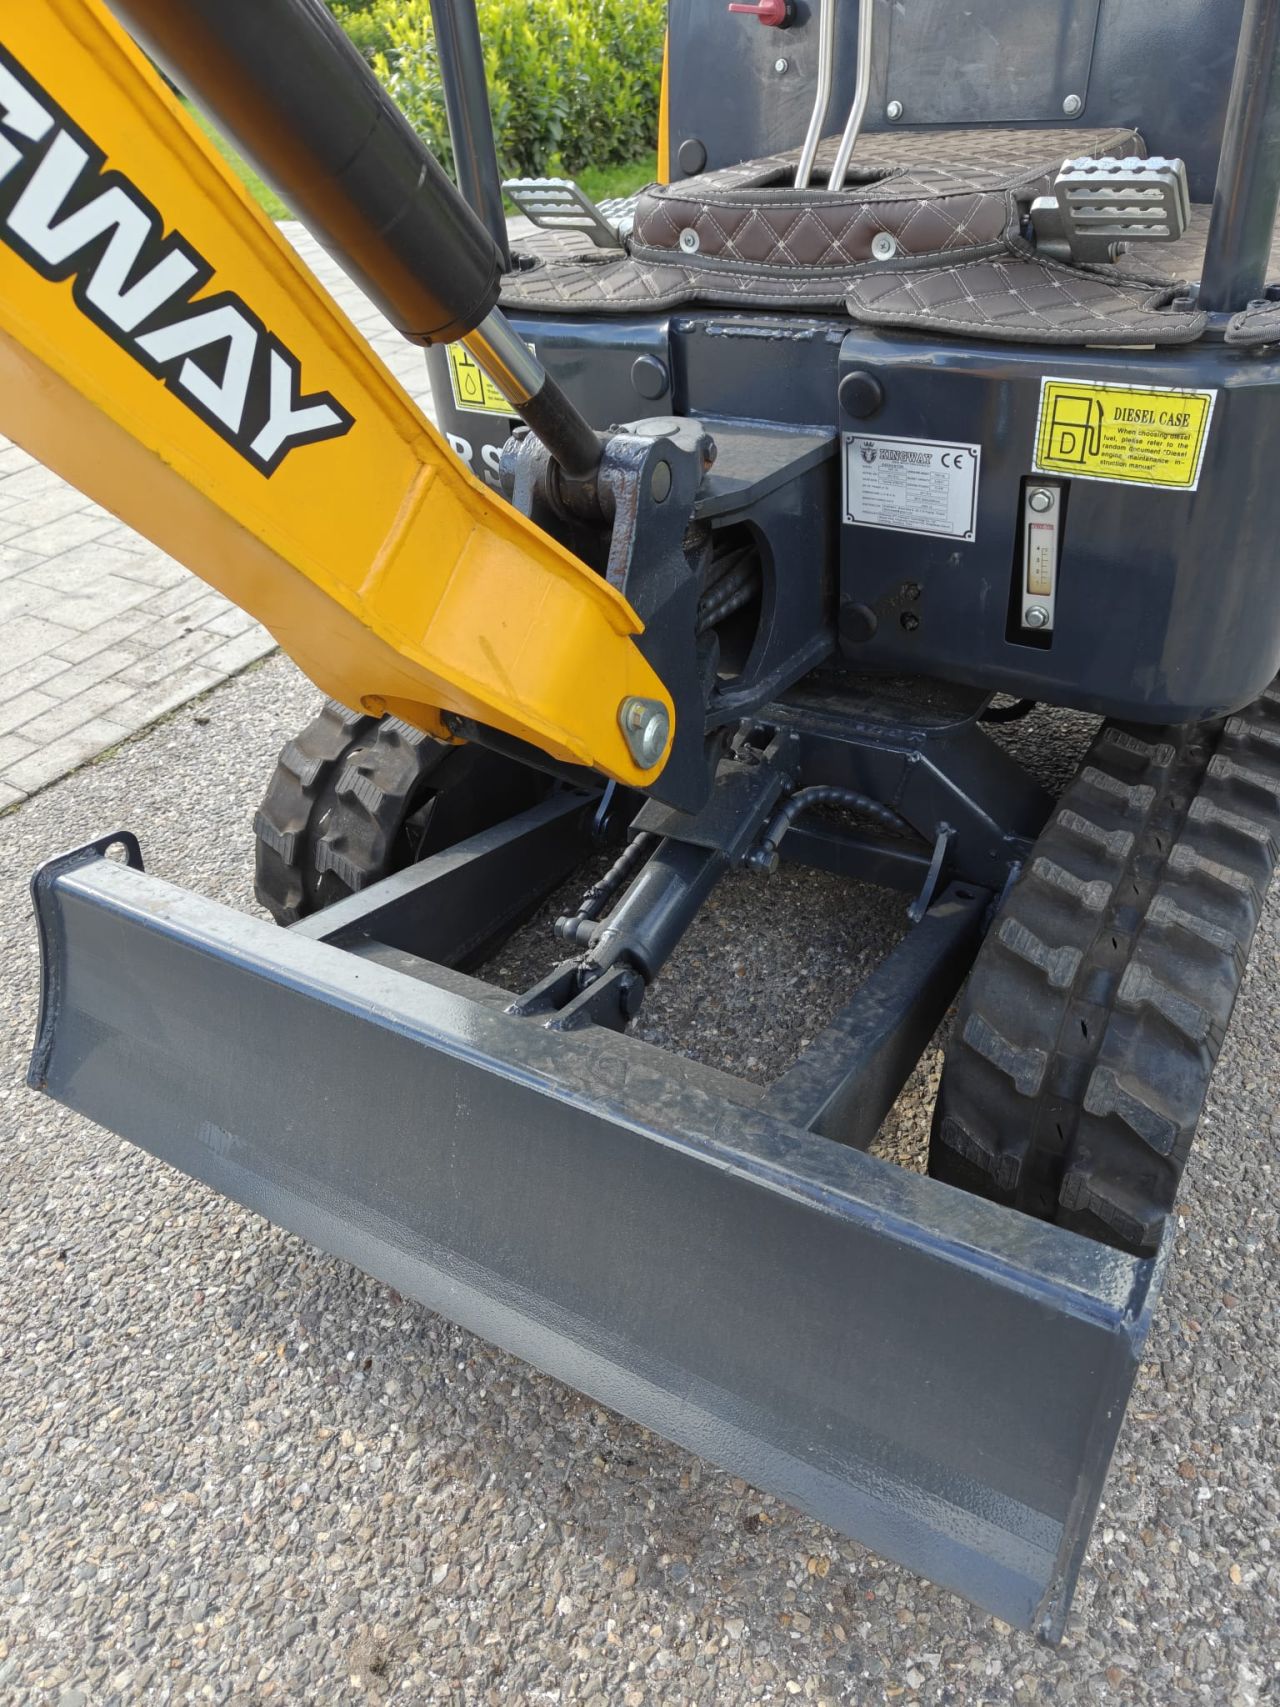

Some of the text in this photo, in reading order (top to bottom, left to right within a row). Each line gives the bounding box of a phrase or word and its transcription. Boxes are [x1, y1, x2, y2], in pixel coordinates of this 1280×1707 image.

[1114, 407, 1191, 427] DIESEL CASE
[1117, 427, 1136, 435] When
[1060, 431, 1076, 454] D
[1102, 443, 1127, 451] random
[879, 448, 964, 470] KINGWAY CE
